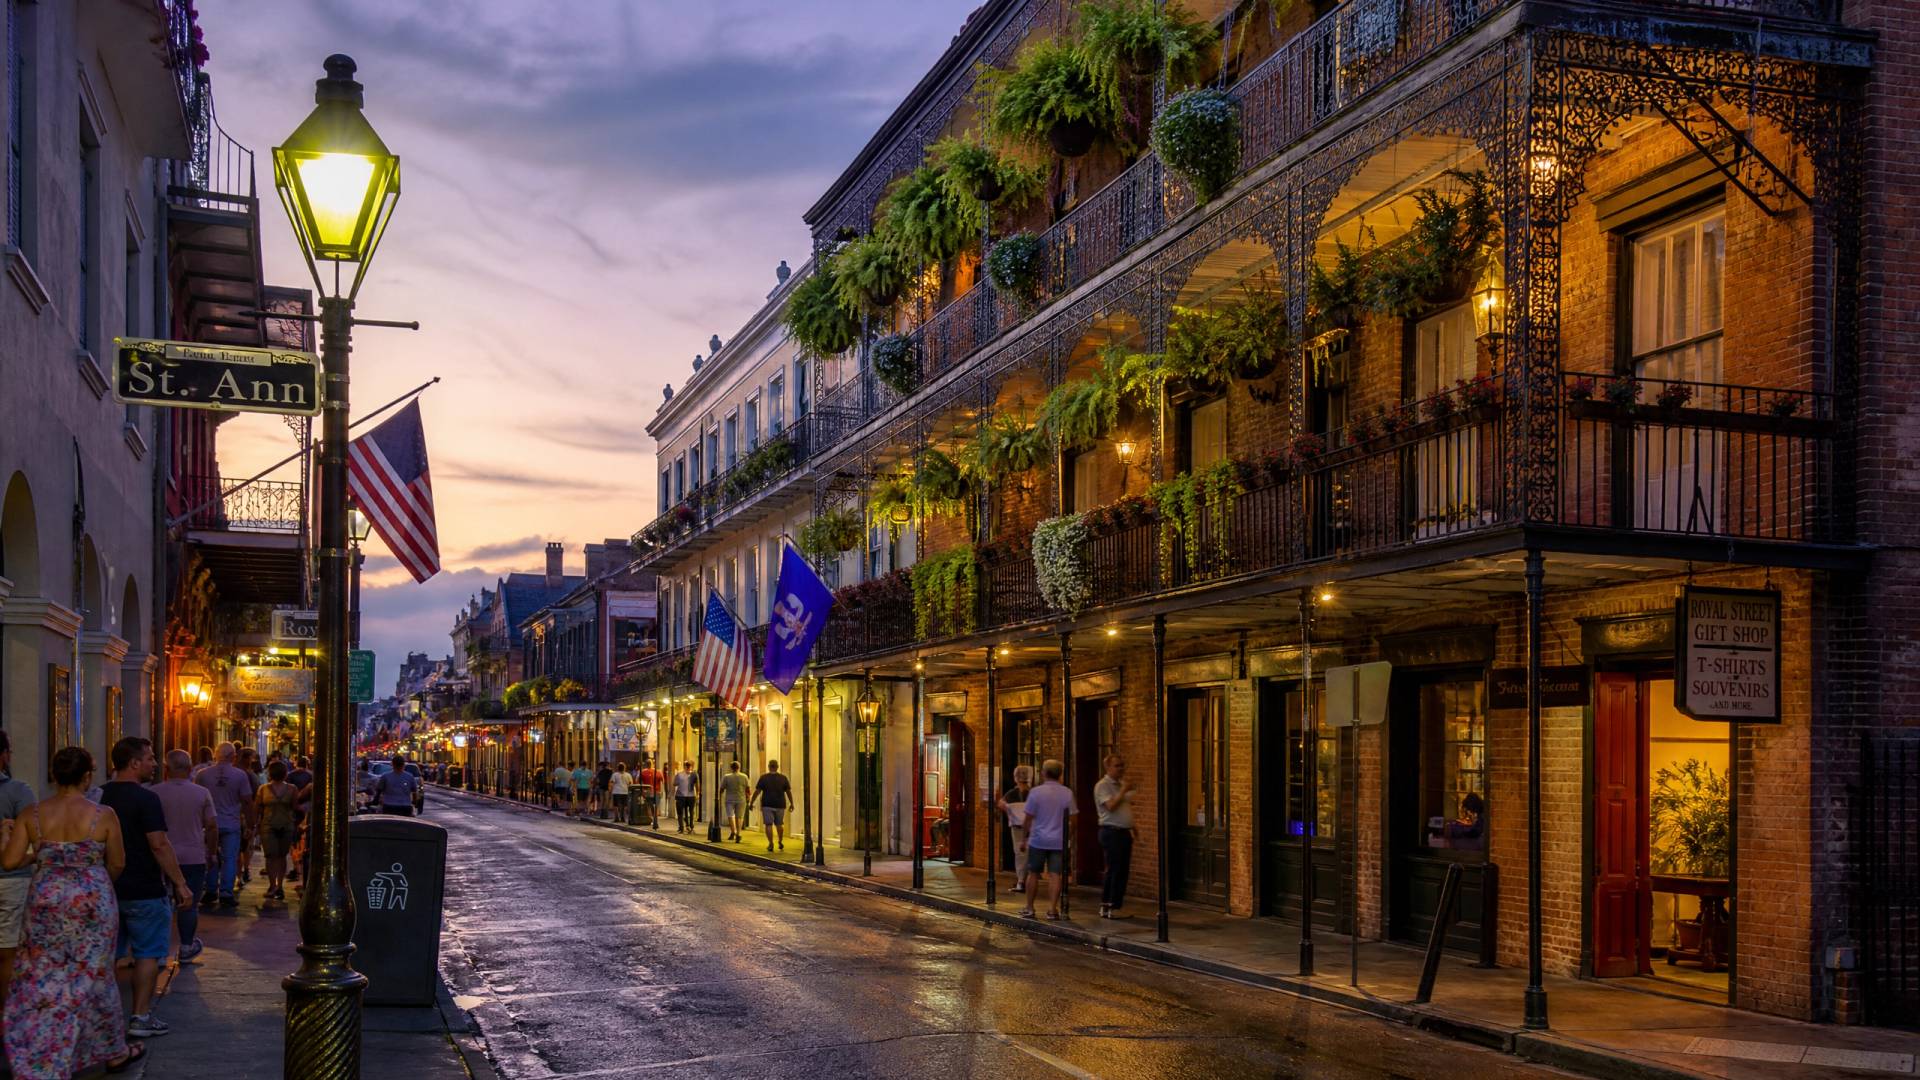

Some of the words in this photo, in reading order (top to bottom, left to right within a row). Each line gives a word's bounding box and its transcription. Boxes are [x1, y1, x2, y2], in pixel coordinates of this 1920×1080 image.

[128, 362, 189, 397] St.
[209, 368, 307, 404] Ann
[1690, 600, 1727, 619] ROYAL
[1730, 602, 1773, 622] STREET
[1694, 624, 1727, 641] GIFT
[1732, 626, 1769, 643] SHOP
[1697, 656, 1766, 675] T-SHIRTS
[1692, 680, 1769, 698] SOUVENIRS
